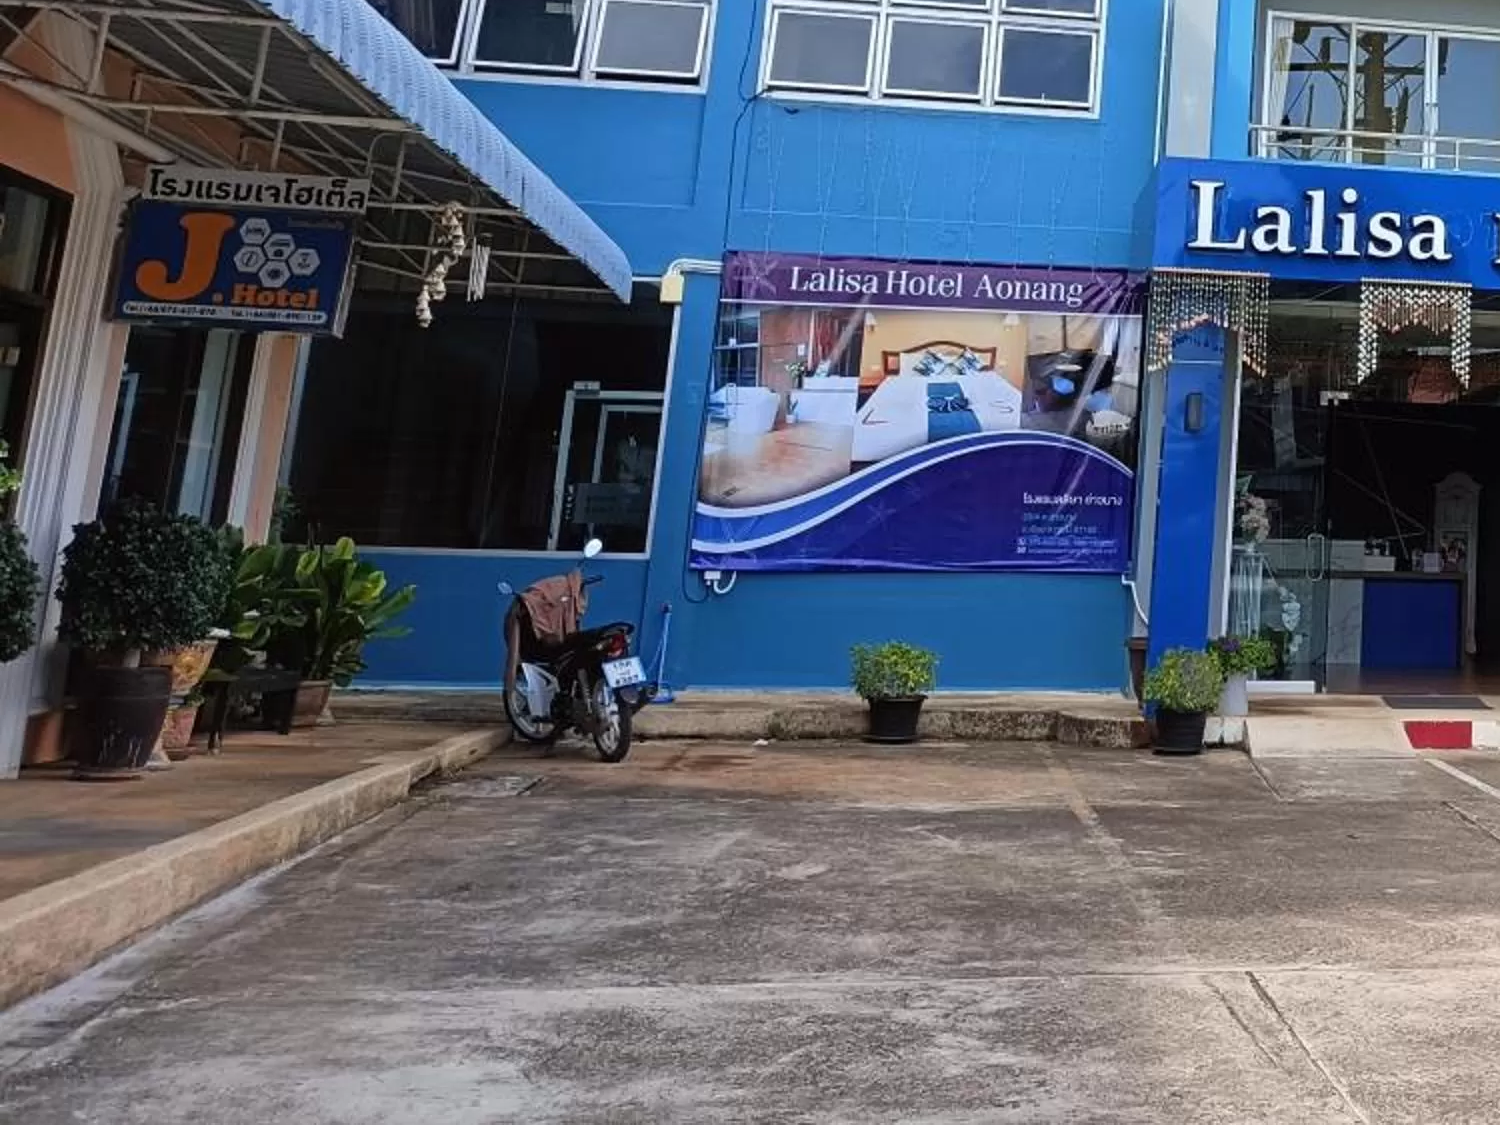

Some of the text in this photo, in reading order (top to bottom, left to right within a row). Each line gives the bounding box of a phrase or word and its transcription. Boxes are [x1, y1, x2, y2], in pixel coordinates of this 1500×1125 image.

[1188, 180, 1453, 261] Lalisa
[231, 282, 320, 309] Hotel
[789, 266, 1084, 307] Lalisa Hotel Aonang
